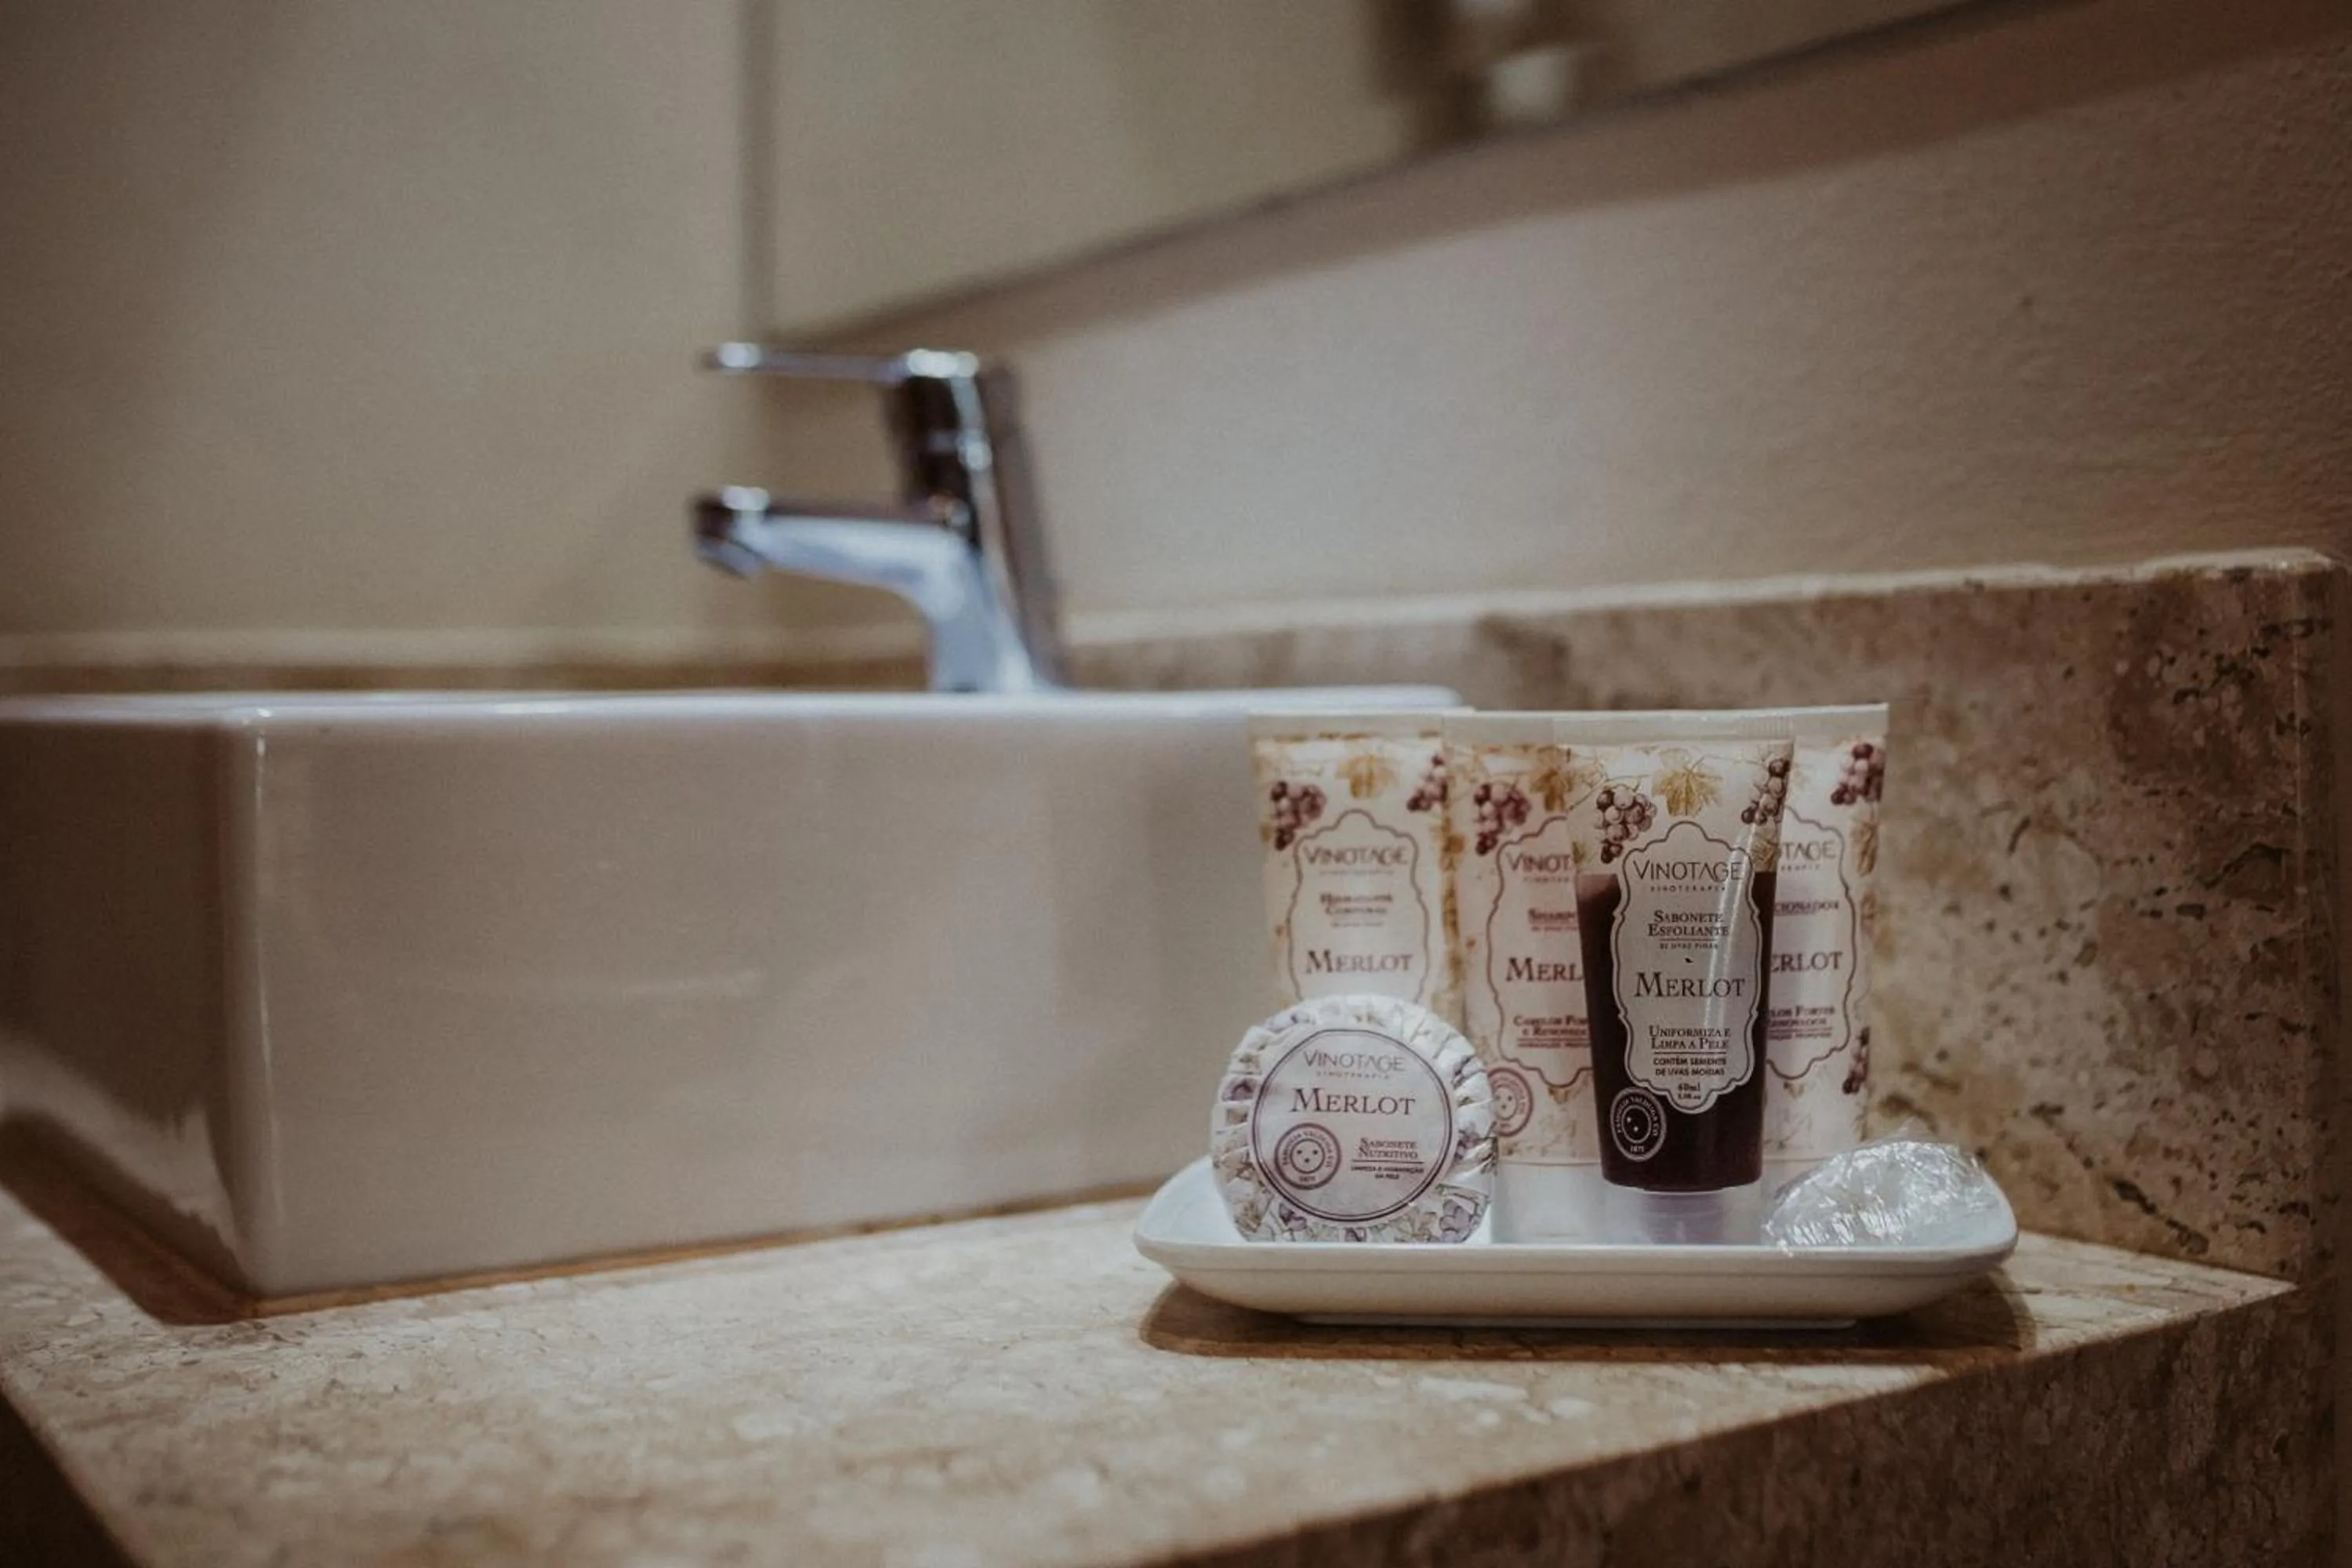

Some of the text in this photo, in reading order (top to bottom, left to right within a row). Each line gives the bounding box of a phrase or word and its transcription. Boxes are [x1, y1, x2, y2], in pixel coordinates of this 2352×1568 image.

[1303, 847, 1408, 866] VINOTAGE
[1781, 840, 1837, 861] TAGE
[1505, 851, 1570, 873] VINOT
[1633, 859, 1744, 883] VINOTAGE
[1653, 909, 1724, 923] SABONETE
[1648, 923, 1729, 937] ESFOLIANTE
[1305, 949, 1414, 974] MERLOT
[1505, 956, 1584, 982] MERL
[1771, 950, 1843, 974] ERLOT
[1634, 971, 1746, 997] MERLOT
[1649, 1025, 1721, 1037] UNIFORMIZA
[1650, 1037, 1730, 1049] LIMPA A PELE
[1303, 1049, 1406, 1073] VINOTAGE
[1656, 1068, 1665, 1076] DE
[1668, 1068, 1689, 1076] UVAS
[1288, 1087, 1416, 1116] MERLOT
